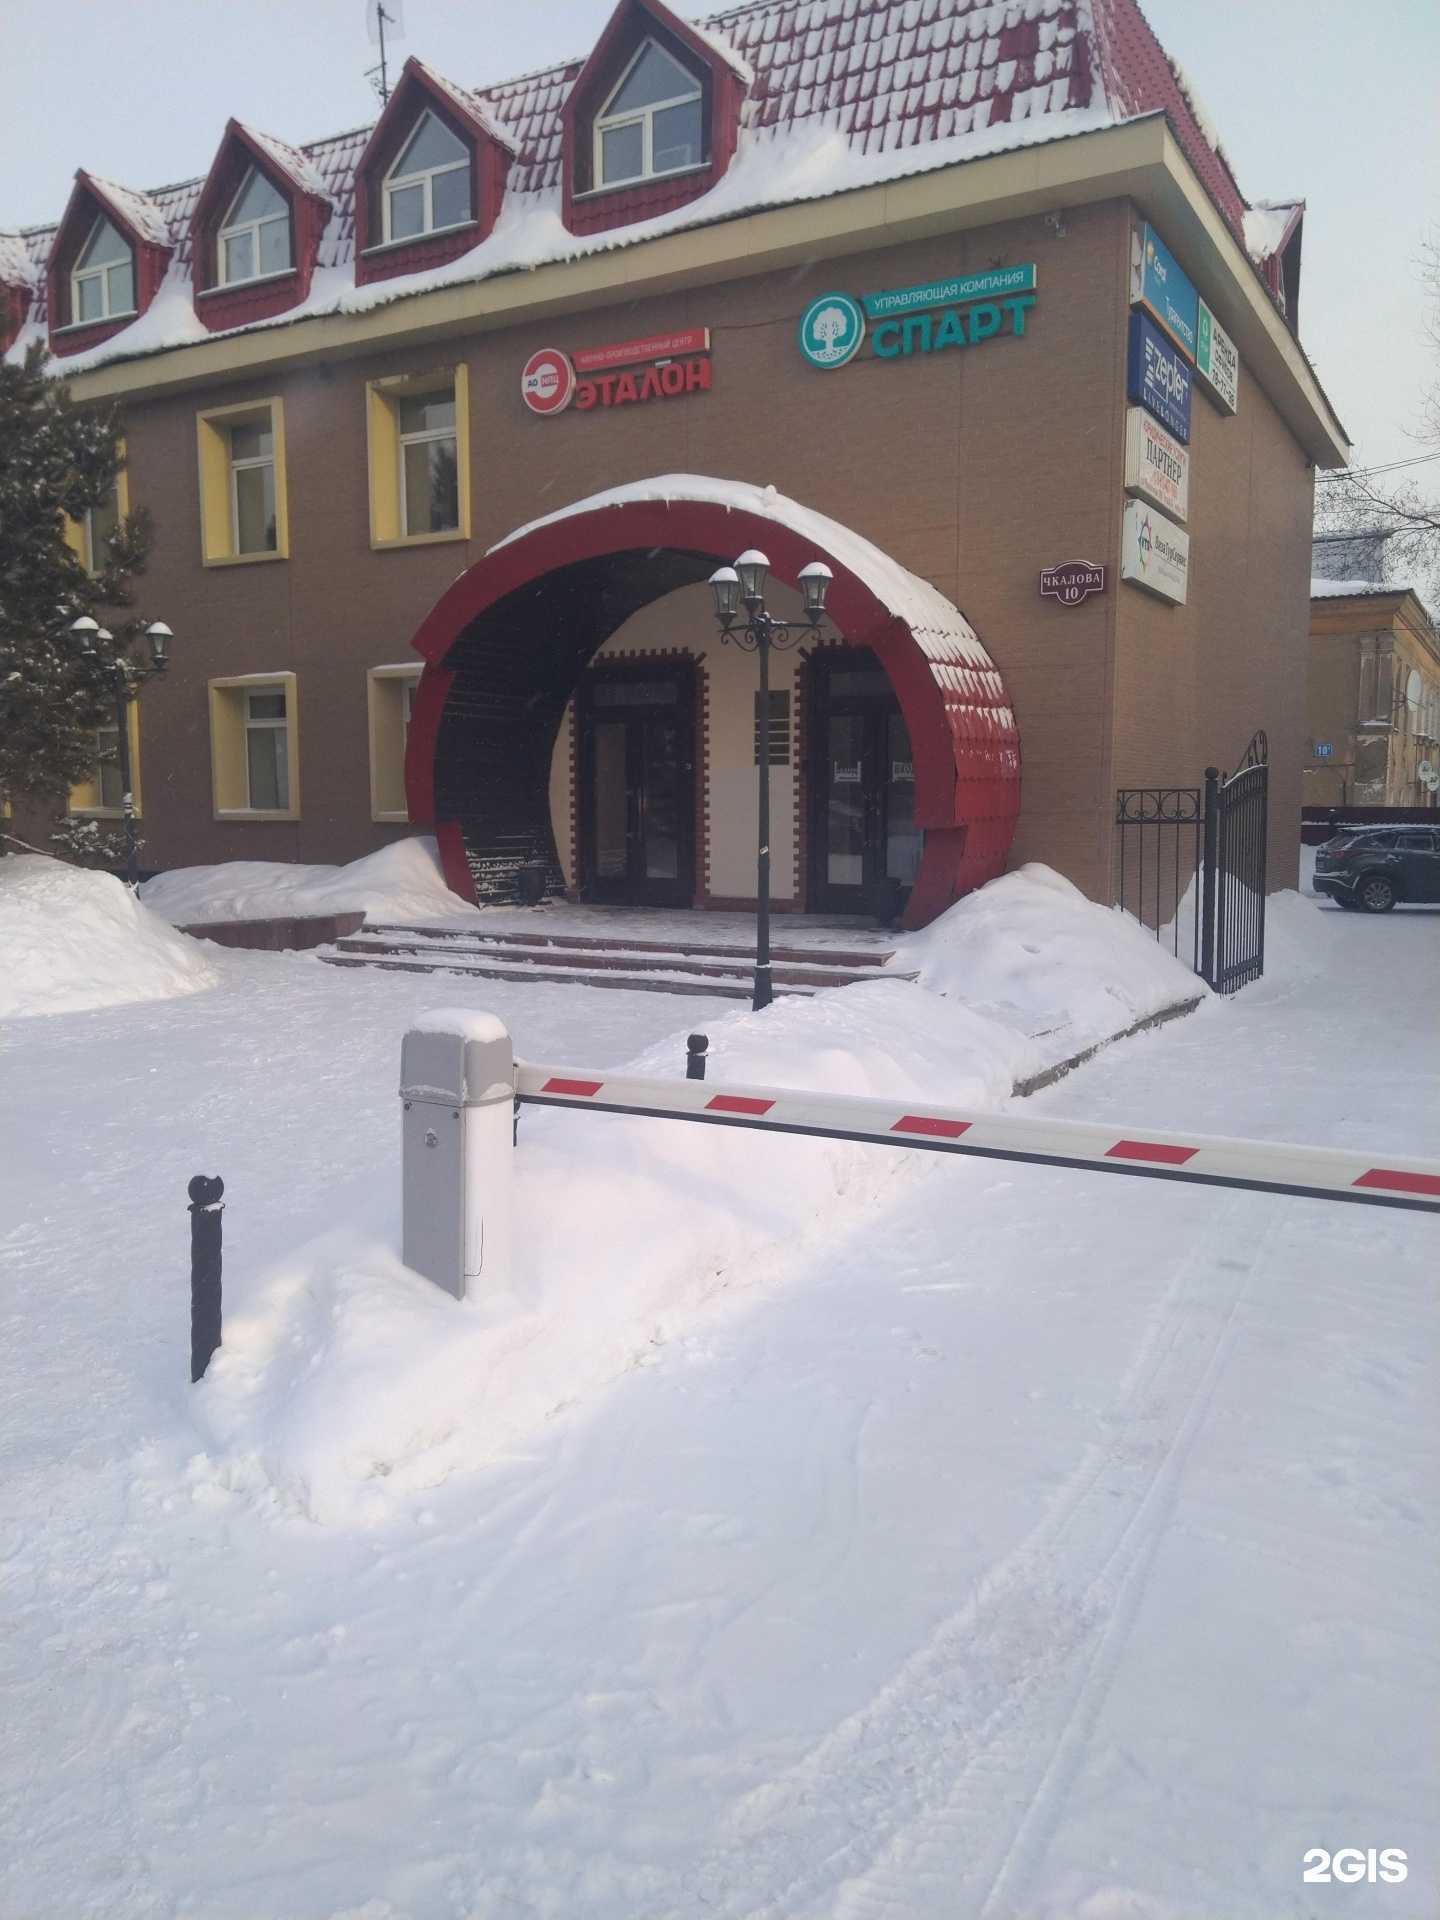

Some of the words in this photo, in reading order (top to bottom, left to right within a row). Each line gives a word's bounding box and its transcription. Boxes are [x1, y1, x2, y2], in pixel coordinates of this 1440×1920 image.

[874, 285, 958, 310] УПРАВЛЯЮЩАЯ
[960, 271, 1024, 296] КОМПАНИЯ
[871, 295, 1037, 359] СПАРТ
[575, 357, 713, 410] ЭТАЛОН
[1154, 346, 1189, 407] zepter
[1146, 438, 1182, 486] ПАРТНЕР
[1043, 573, 1100, 587] ЧКАЛОВА
[1065, 586, 1079, 600] 10
